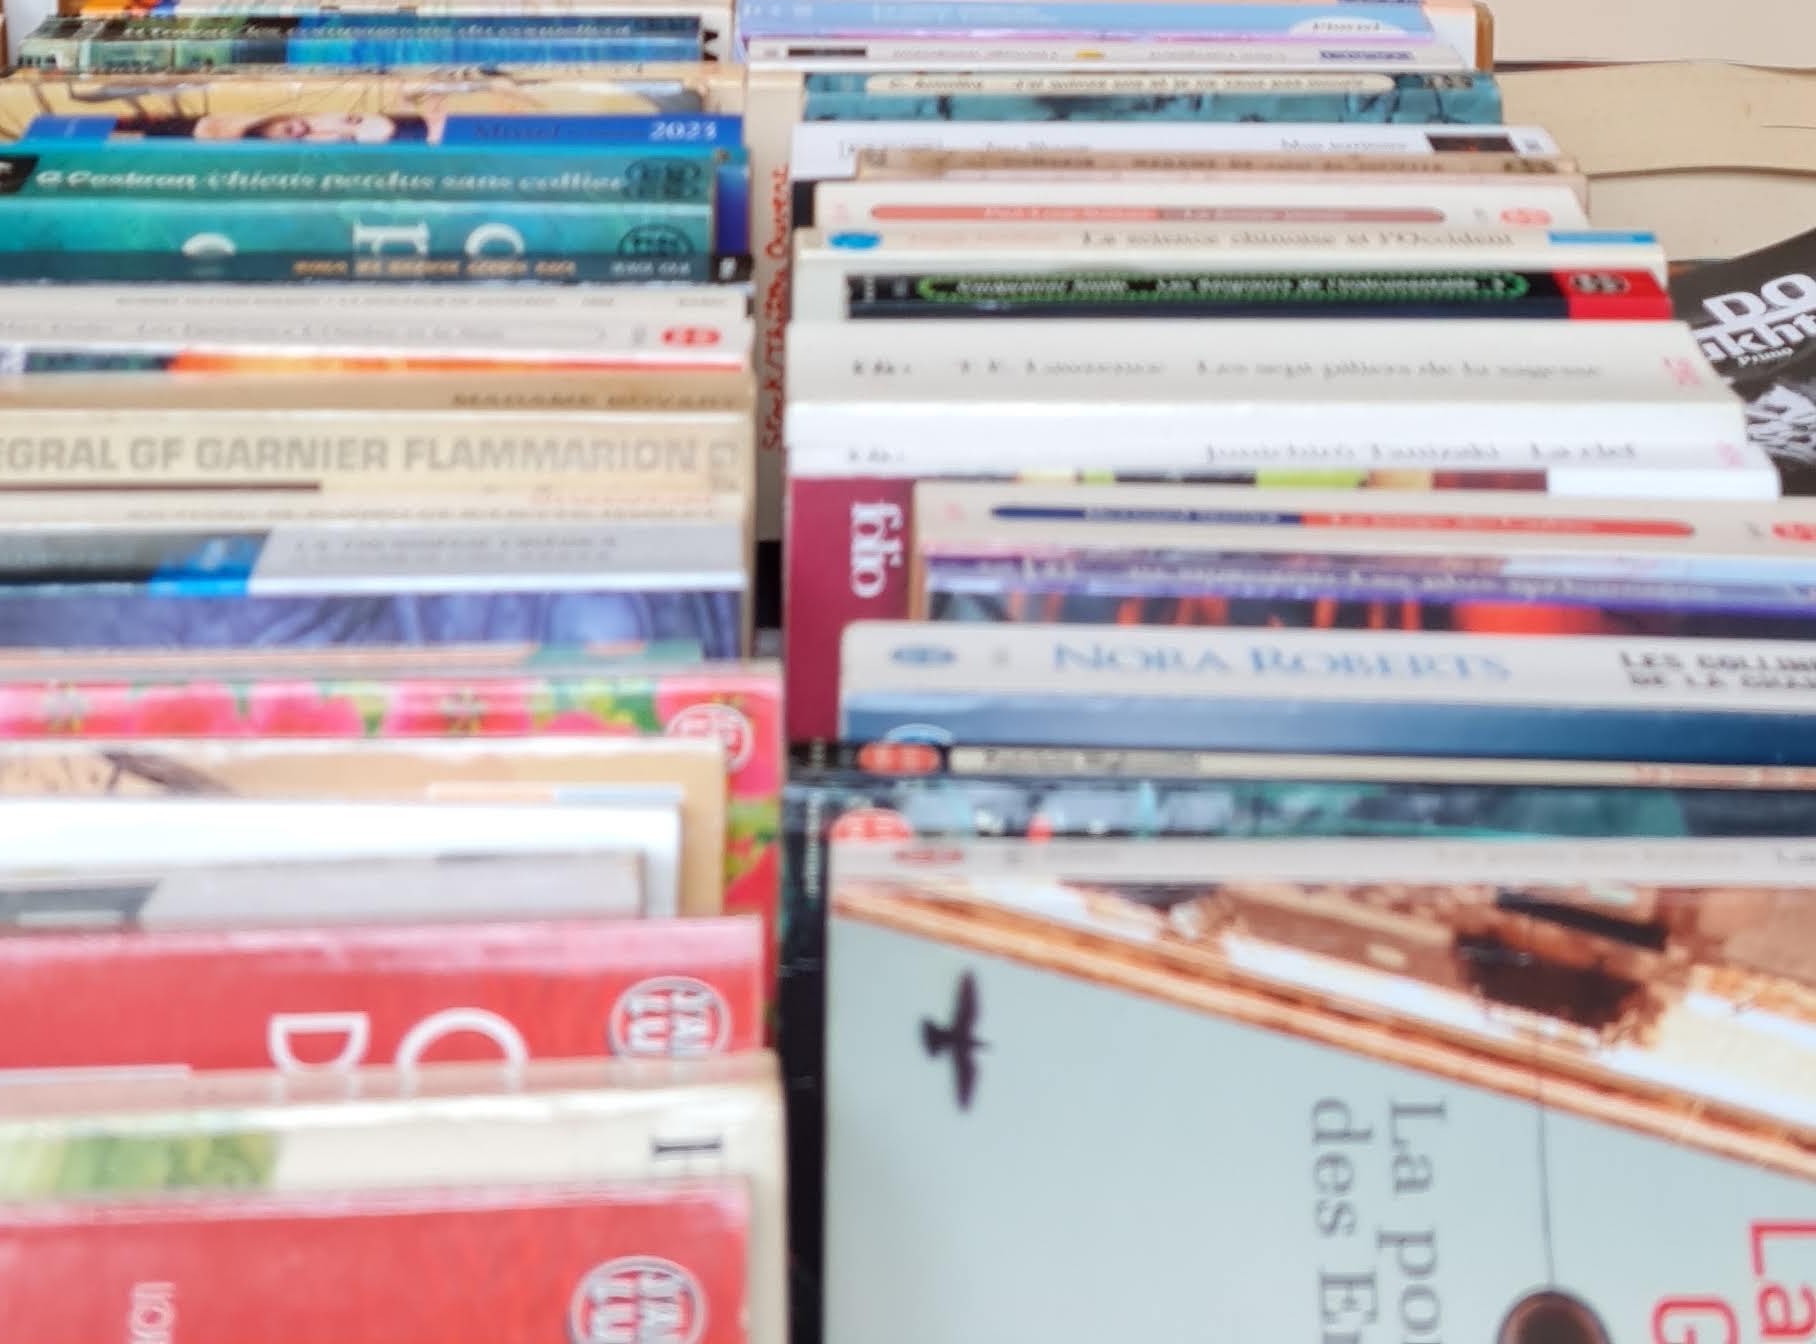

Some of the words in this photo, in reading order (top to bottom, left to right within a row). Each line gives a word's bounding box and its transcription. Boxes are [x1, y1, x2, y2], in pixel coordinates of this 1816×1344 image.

[129, 436, 184, 473] GF
[196, 436, 389, 474] GARNIER
[403, 434, 699, 473] FLAMMARION
[850, 501, 903, 599] folio
[1055, 643, 1230, 673] NORA
[1250, 649, 1512, 681] ROBERTS
[1311, 1097, 1374, 1239] des
[1389, 1097, 1448, 1196] La
